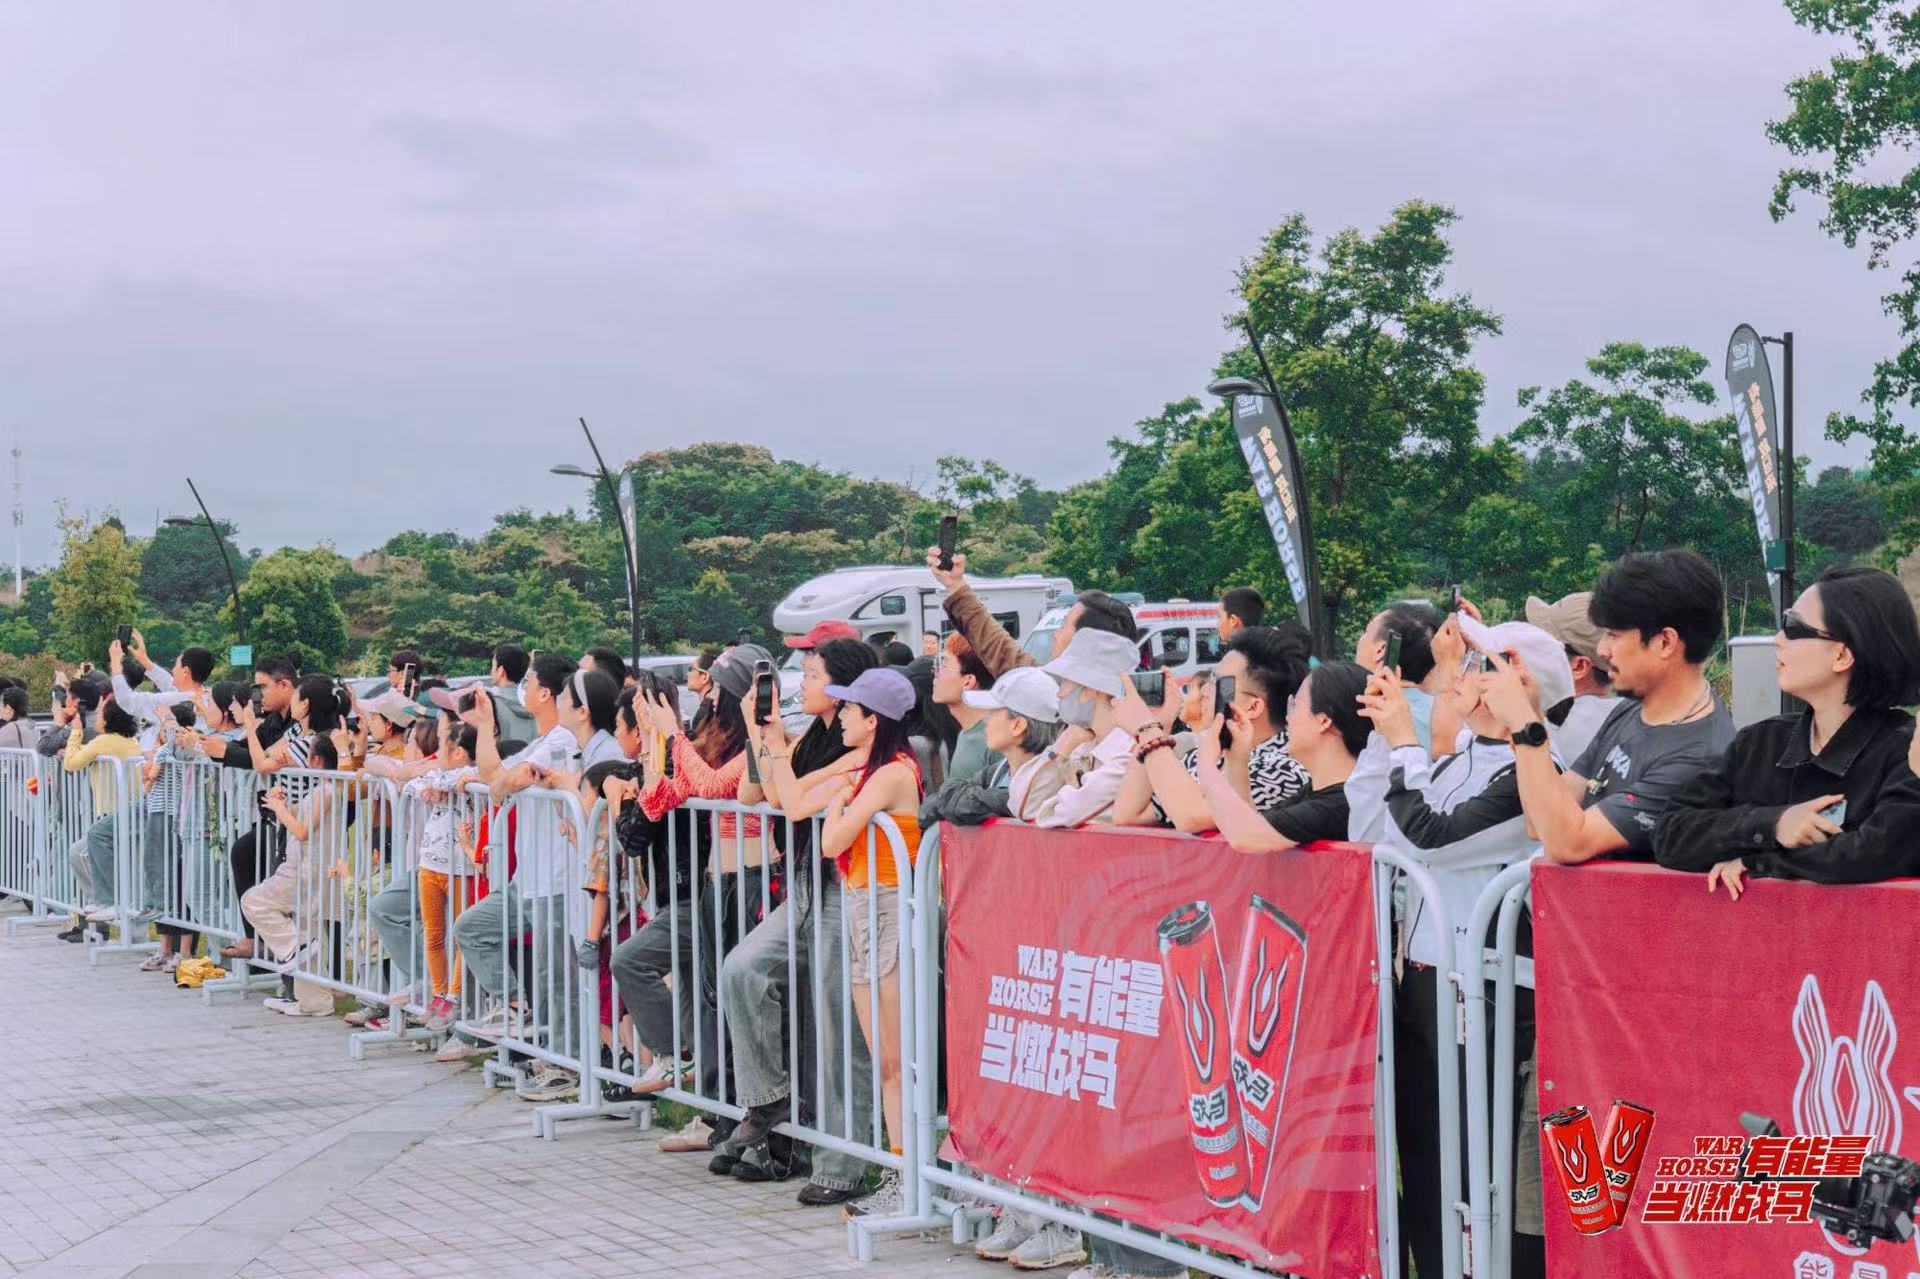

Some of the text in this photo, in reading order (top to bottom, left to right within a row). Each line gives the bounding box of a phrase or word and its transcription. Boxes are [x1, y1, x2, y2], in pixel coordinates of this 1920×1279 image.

[1017, 944, 1059, 981] WAR
[1058, 950, 1165, 1038] 有能量
[988, 975, 1055, 1016] HORSE
[979, 1012, 1121, 1110] 当燃战马
